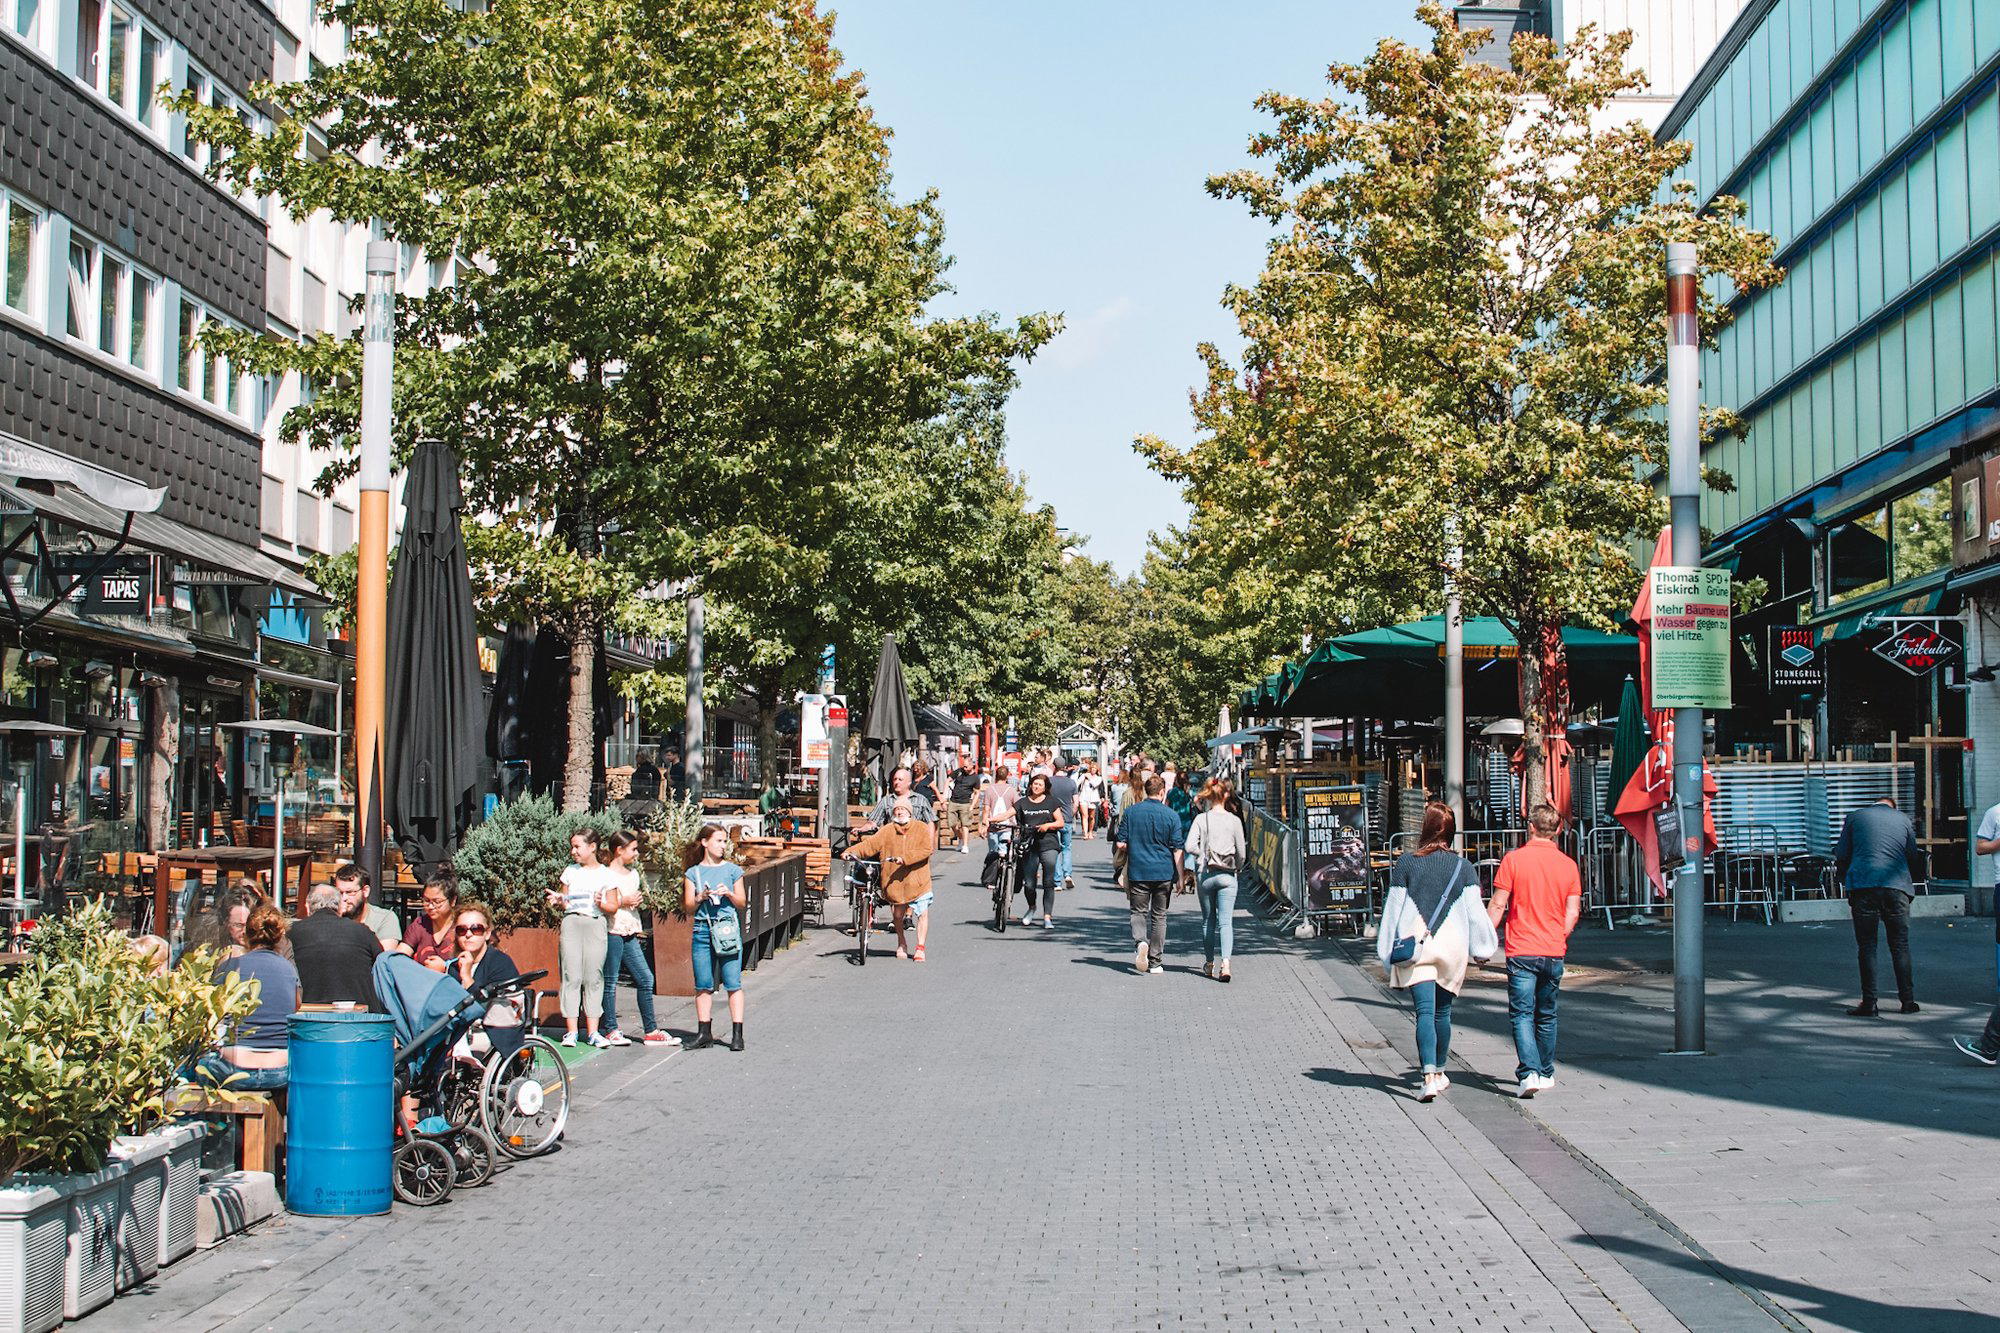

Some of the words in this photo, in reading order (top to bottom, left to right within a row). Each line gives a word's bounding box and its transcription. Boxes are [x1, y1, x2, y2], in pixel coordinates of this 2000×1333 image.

[1656, 572, 1699, 583] Thomas
[1706, 573, 1723, 585] SPD
[102, 580, 140, 599] TAPAS
[1656, 584, 1699, 595] Eiskirch
[1707, 585, 1729, 597] Grüne
[1656, 605, 1683, 614] Mehr
[1685, 604, 1715, 616] Bäume
[1716, 607, 1728, 617] und
[1656, 618, 1695, 628] Wasser
[1696, 619, 1719, 631] gegen
[1720, 621, 1728, 630] zu
[1656, 630, 1675, 641] viel
[1677, 630, 1704, 641] Hitze.
[1775, 669, 1821, 678] STONEGRILL
[1314, 793, 1332, 802] THREE
[1332, 792, 1349, 802] SIXTY
[1308, 815, 1340, 829] SPARE
[1308, 828, 1333, 842] RIBS
[1309, 841, 1333, 856] DEAL
